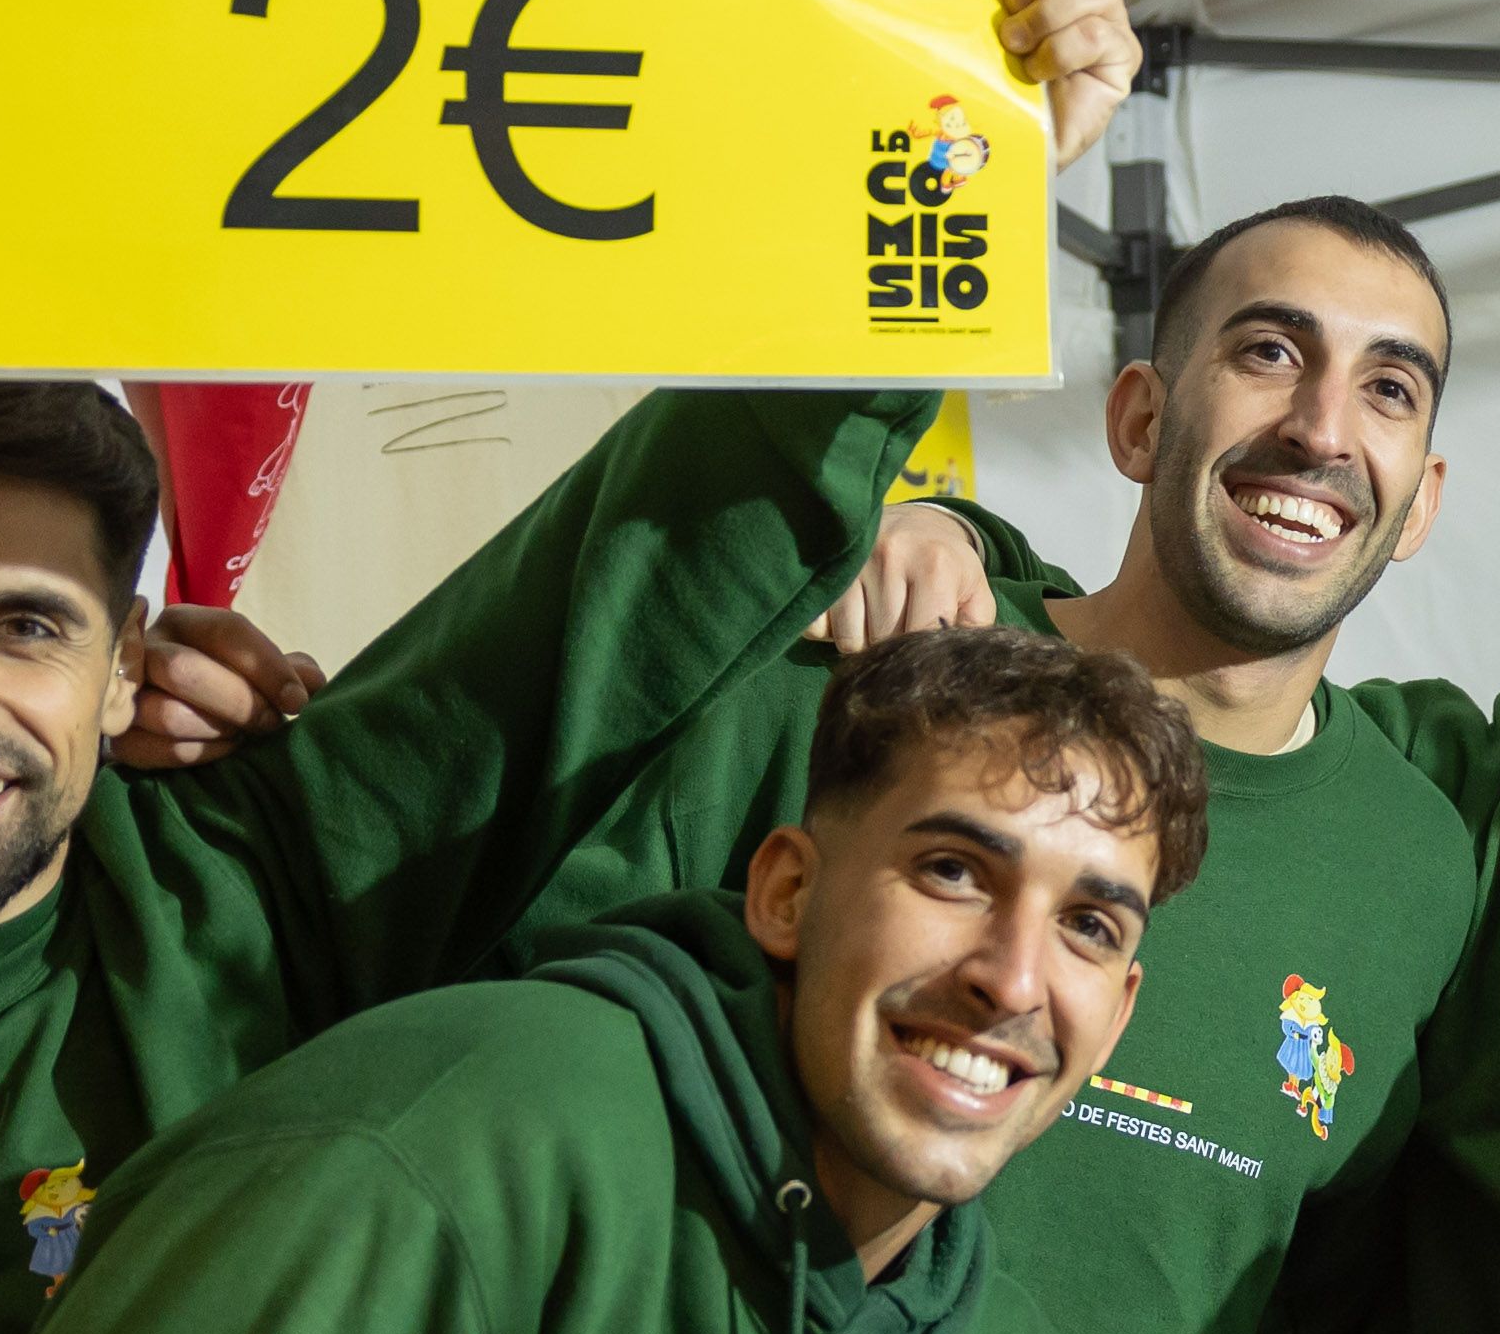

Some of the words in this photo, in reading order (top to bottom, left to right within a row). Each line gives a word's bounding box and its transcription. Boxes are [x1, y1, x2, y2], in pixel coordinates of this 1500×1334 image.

[871, 129, 911, 153] LA
[866, 159, 953, 208] CO
[867, 212, 989, 260] MIS
[1077, 1103, 1105, 1126] DE
[1106, 1111, 1172, 1145] FESTES
[1174, 1131, 1219, 1160] SANT
[1218, 1147, 1264, 1180] MARTÍ
